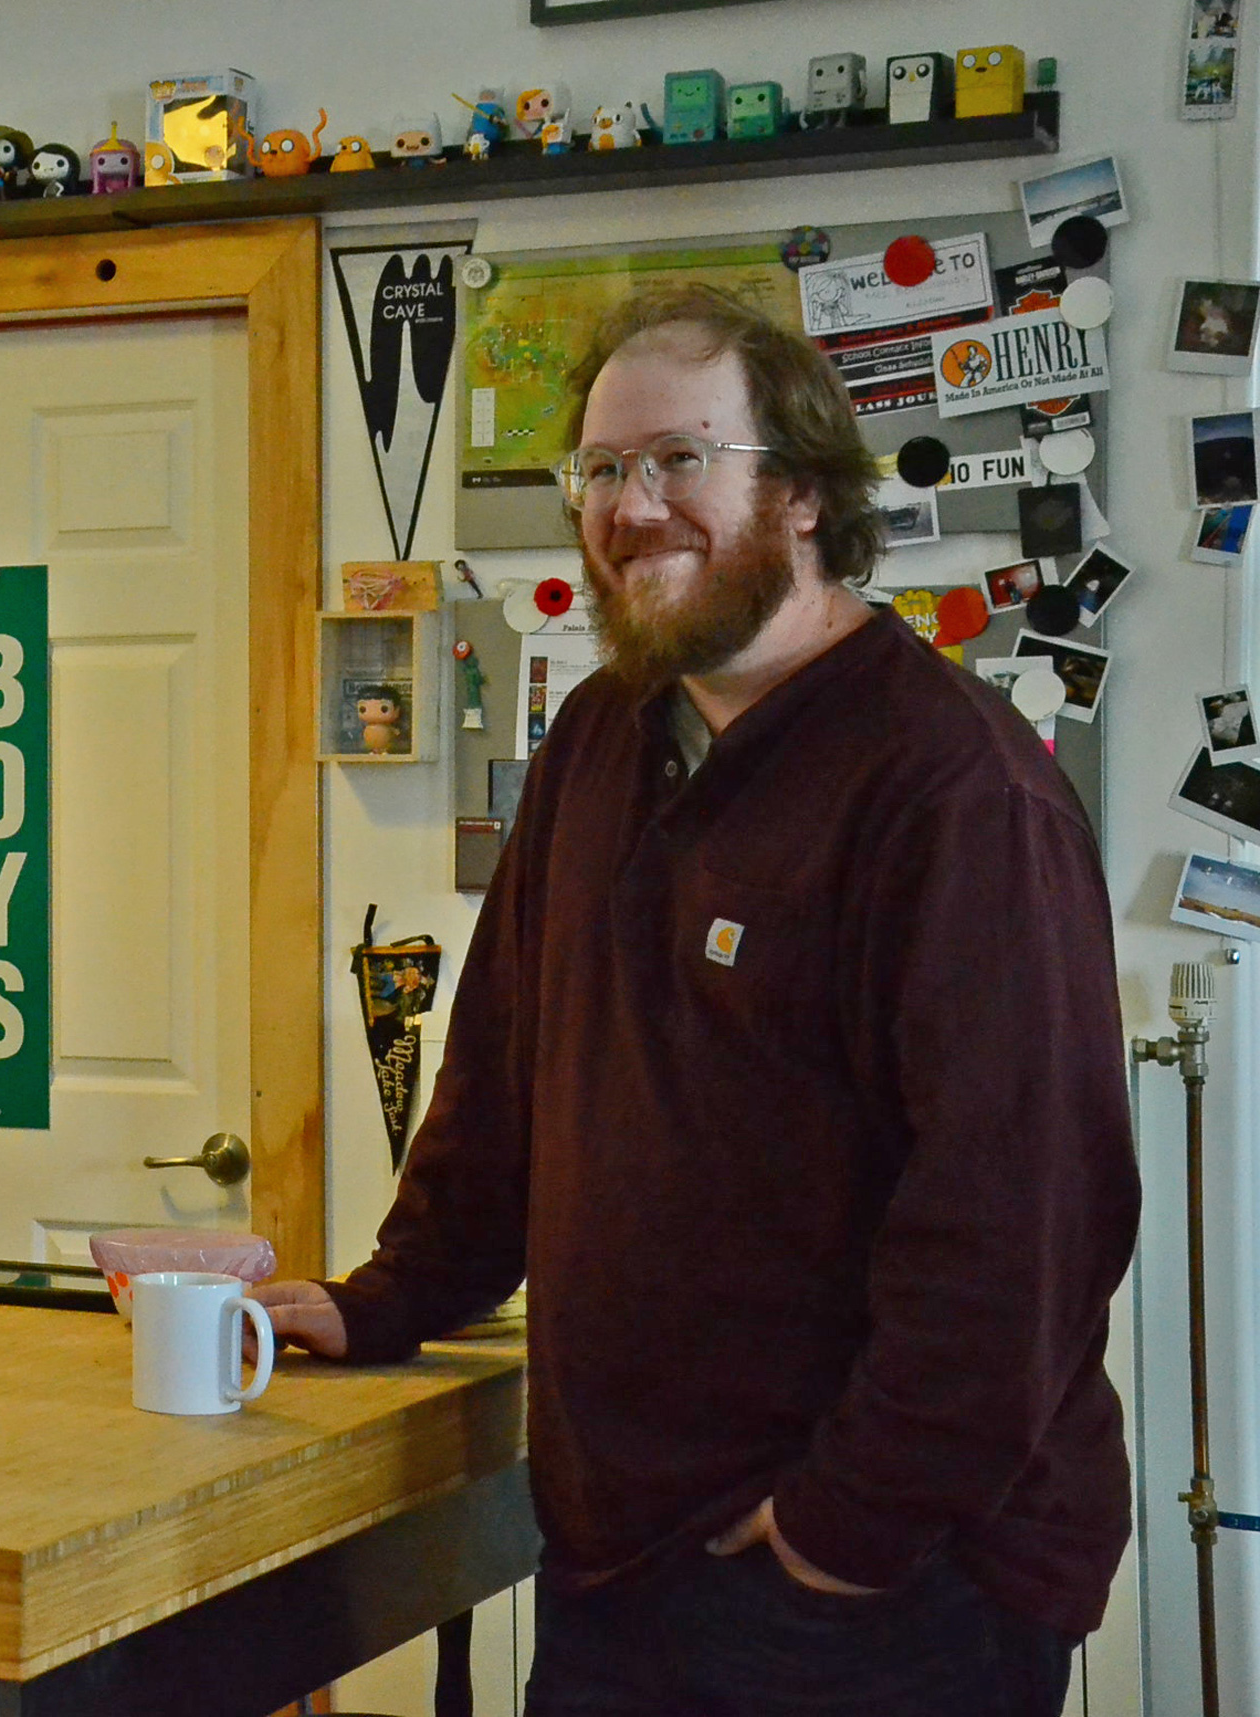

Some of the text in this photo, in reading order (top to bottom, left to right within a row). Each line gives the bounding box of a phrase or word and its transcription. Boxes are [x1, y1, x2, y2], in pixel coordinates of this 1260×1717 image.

[949, 252, 975, 271] TO
[382, 282, 444, 300] CRYSTAL
[383, 303, 425, 319] CAVE
[991, 320, 1091, 382] HENRY
[945, 366, 1103, 403] Made In America Or Not Made At All
[856, 399, 892, 412] LASS
[983, 456, 1025, 481] FUN
[374, 1057, 396, 1098] Lake
[384, 1035, 417, 1112] Meadow
